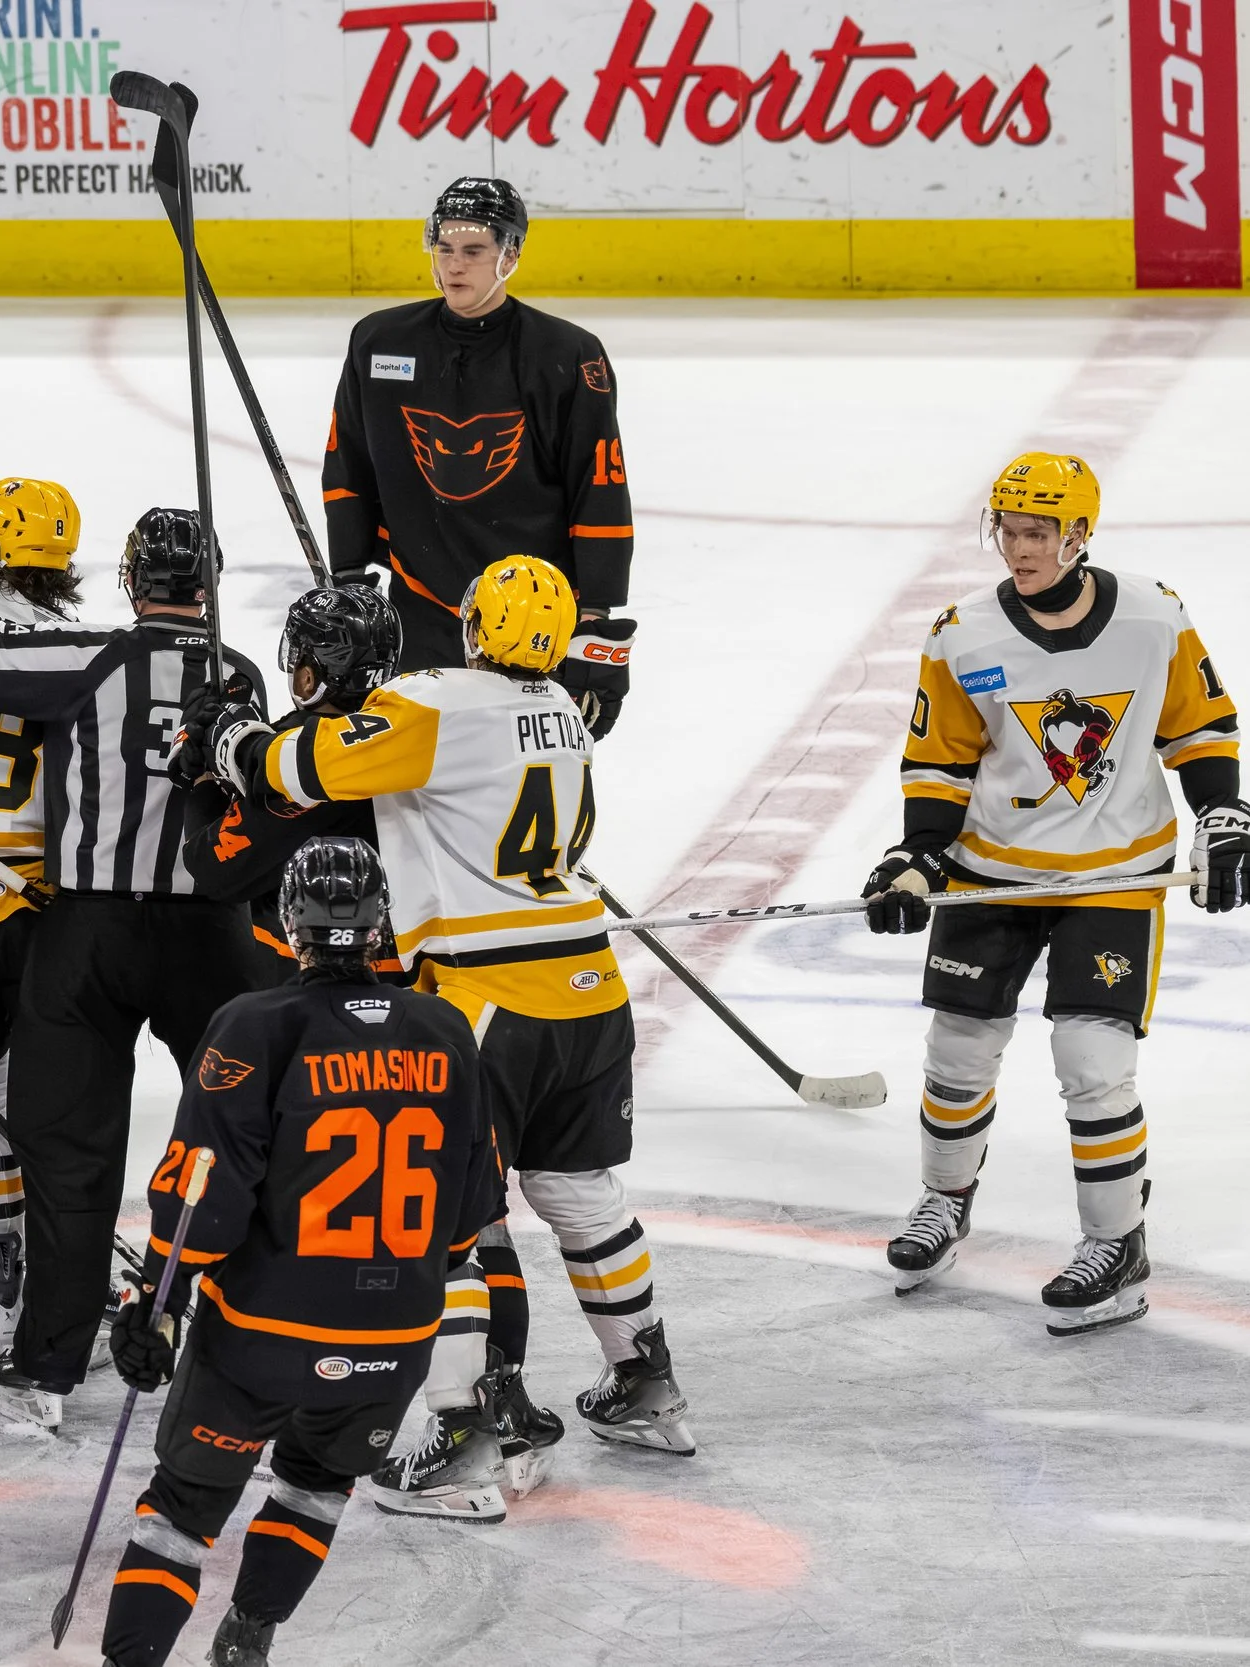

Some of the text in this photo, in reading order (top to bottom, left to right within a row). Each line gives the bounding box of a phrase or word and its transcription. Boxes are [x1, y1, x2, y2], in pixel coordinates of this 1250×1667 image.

[340, 0, 1053, 148] Tim Hortons
[1159, 0, 1206, 231] CCM
[16, 164, 120, 194] PERFECT
[128, 164, 155, 194] HA
[191, 164, 252, 194] RICK.
[374, 362, 401, 372] Capital
[592, 438, 626, 486] 19
[55, 517, 64, 537] 8
[313, 596, 332, 608] ppl
[175, 637, 209, 645] CCM
[530, 632, 551, 653] 44
[583, 642, 630, 663] CC
[365, 668, 384, 689] 74
[521, 685, 549, 694] CCM
[962, 671, 1003, 689] Geisinger
[1196, 655, 1227, 701] 1
[909, 685, 930, 740] 0
[516, 711, 586, 753] PIETILA
[495, 762, 597, 899] 44
[329, 928, 355, 946] 26
[578, 969, 619, 986] AHL CC
[930, 954, 984, 980] CCM
[344, 999, 391, 1010] CCM
[303, 1049, 449, 1097] TOMASINO
[151, 1139, 216, 1200] 26
[297, 1107, 445, 1259] 26
[325, 1361, 399, 1373] AHL CCM
[192, 1424, 267, 1453] CCM
